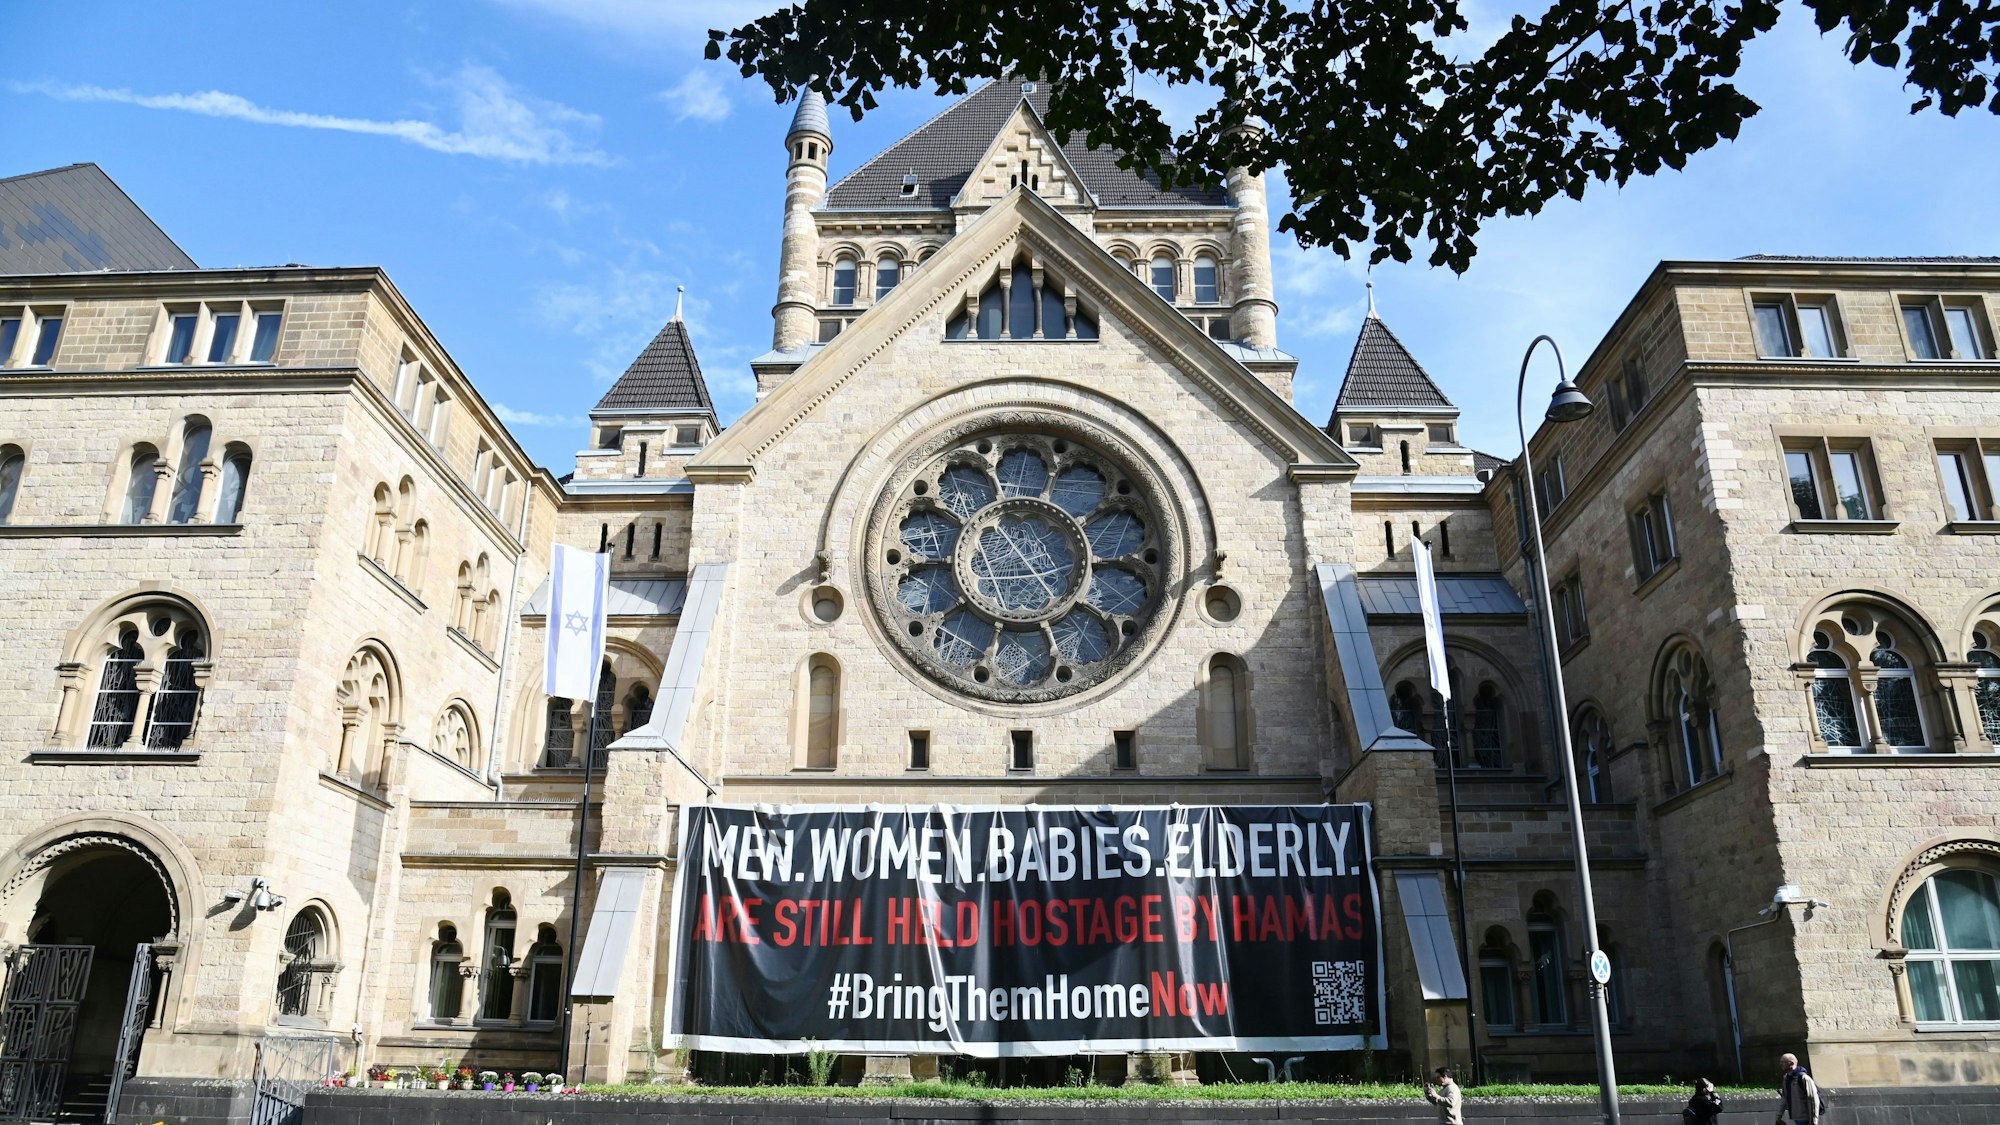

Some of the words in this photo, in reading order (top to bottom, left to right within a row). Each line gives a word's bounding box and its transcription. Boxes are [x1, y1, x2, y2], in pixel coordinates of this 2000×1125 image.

[693, 893, 762, 945] ARE
[773, 897, 872, 947] STILL
[887, 897, 978, 947] HELD
[993, 895, 1163, 947] HOSTAGE
[1176, 894, 1219, 943] BY
[1233, 893, 1362, 942] HAMAS
[828, 971, 1228, 1032] #BringThemHomeNow
